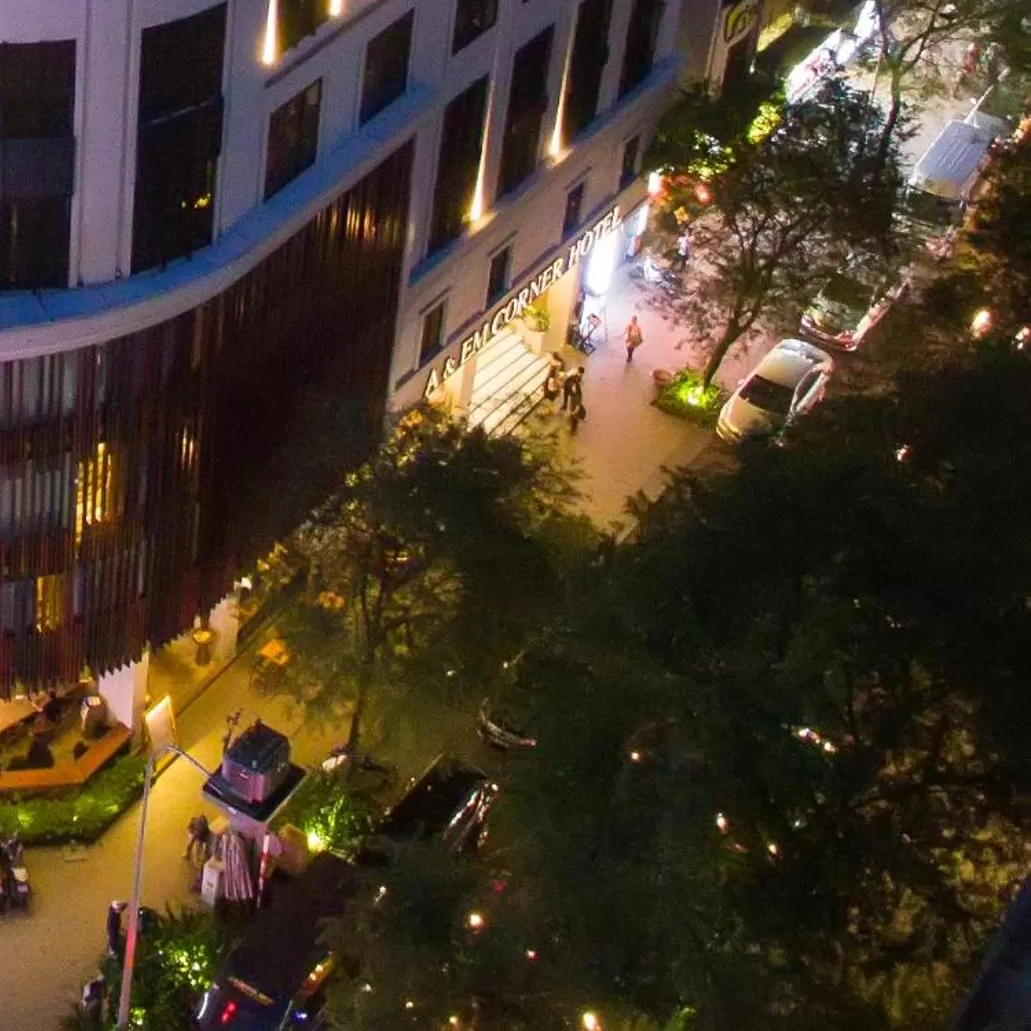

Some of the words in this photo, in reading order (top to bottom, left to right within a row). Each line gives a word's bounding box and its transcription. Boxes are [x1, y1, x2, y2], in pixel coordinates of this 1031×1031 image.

[424, 368, 440, 399] A
[443, 356, 456, 379] &
[460, 322, 490, 365] EM
[491, 258, 566, 335] CORNER
[568, 205, 624, 268] HOTEL
